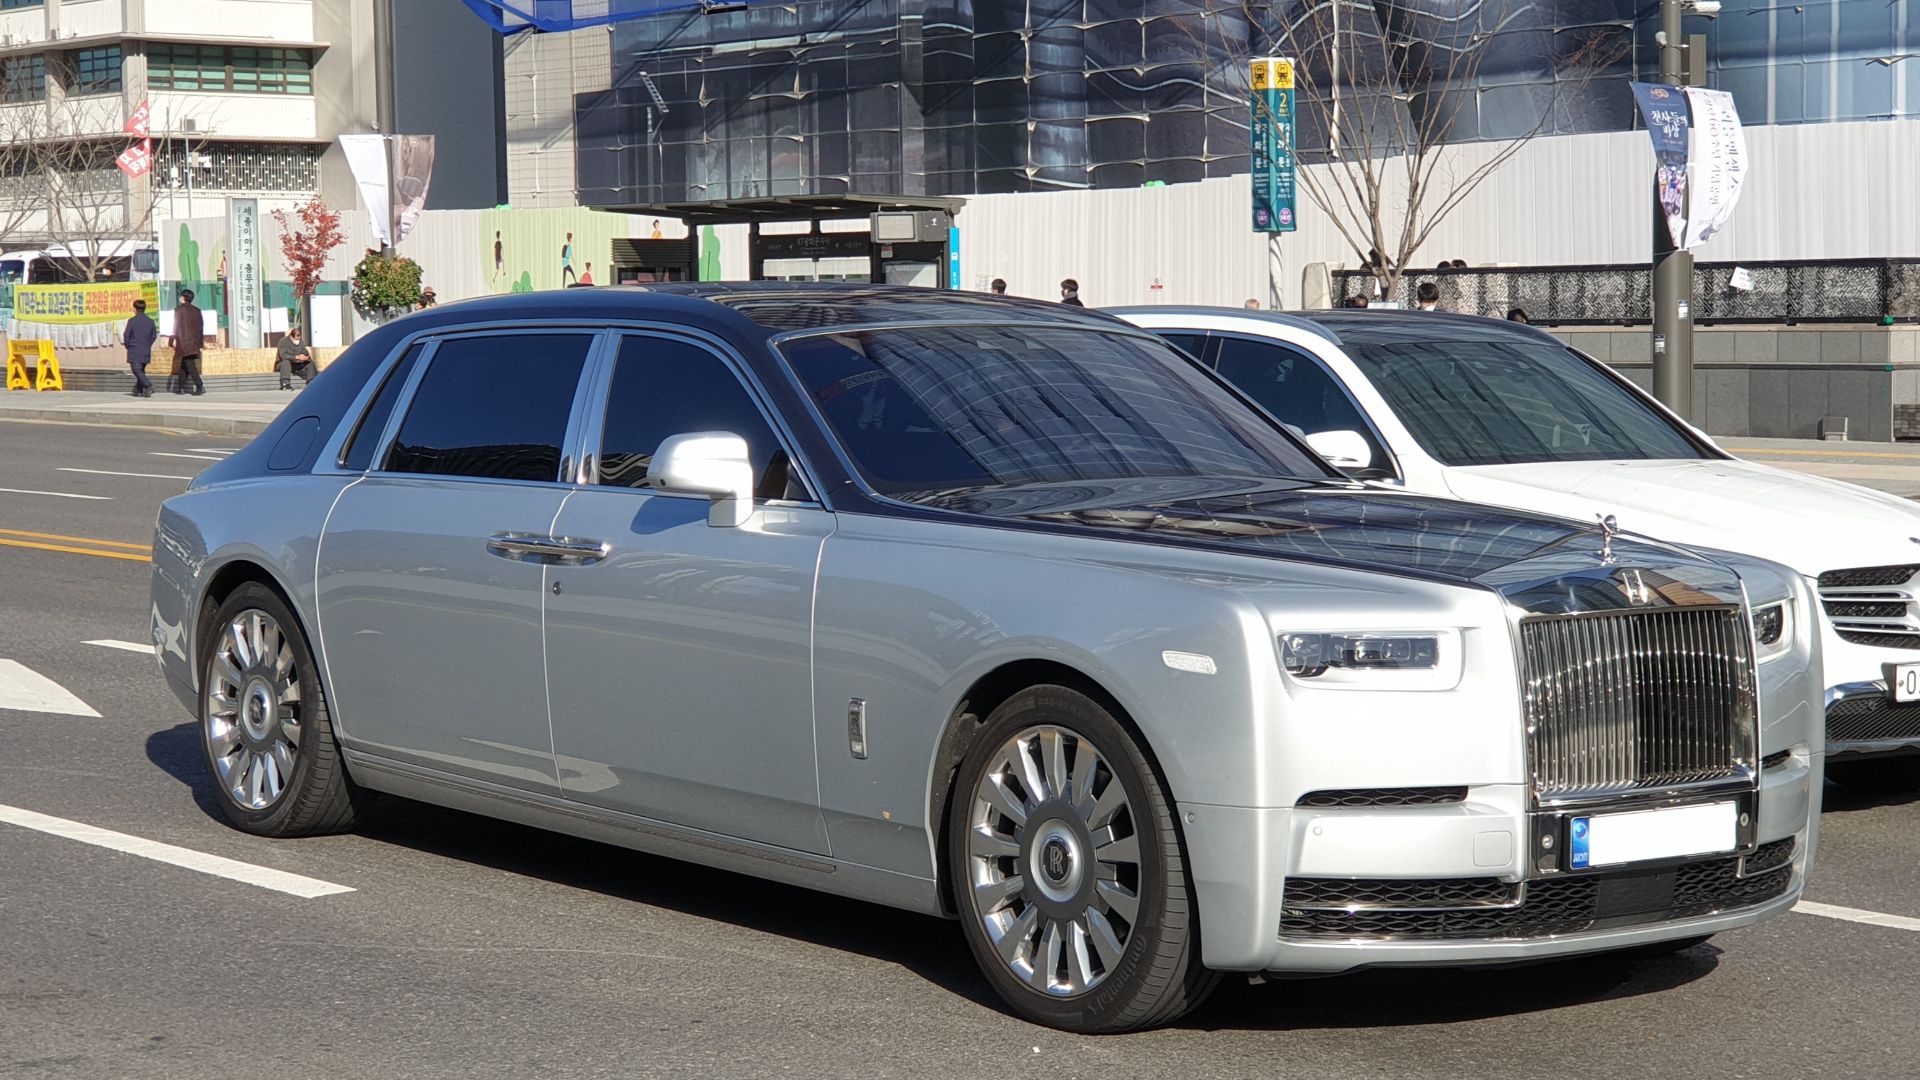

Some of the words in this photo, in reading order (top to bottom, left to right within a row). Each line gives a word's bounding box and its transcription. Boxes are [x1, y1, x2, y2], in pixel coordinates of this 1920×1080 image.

[1279, 93, 1287, 107] 2
[1663, 121, 1680, 138] 비상
[243, 206, 253, 258] 세종이야기
[18, 292, 46, 315] KT민주노조
[72, 291, 84, 315] 주범
[244, 263, 255, 325] 충무공이야기
